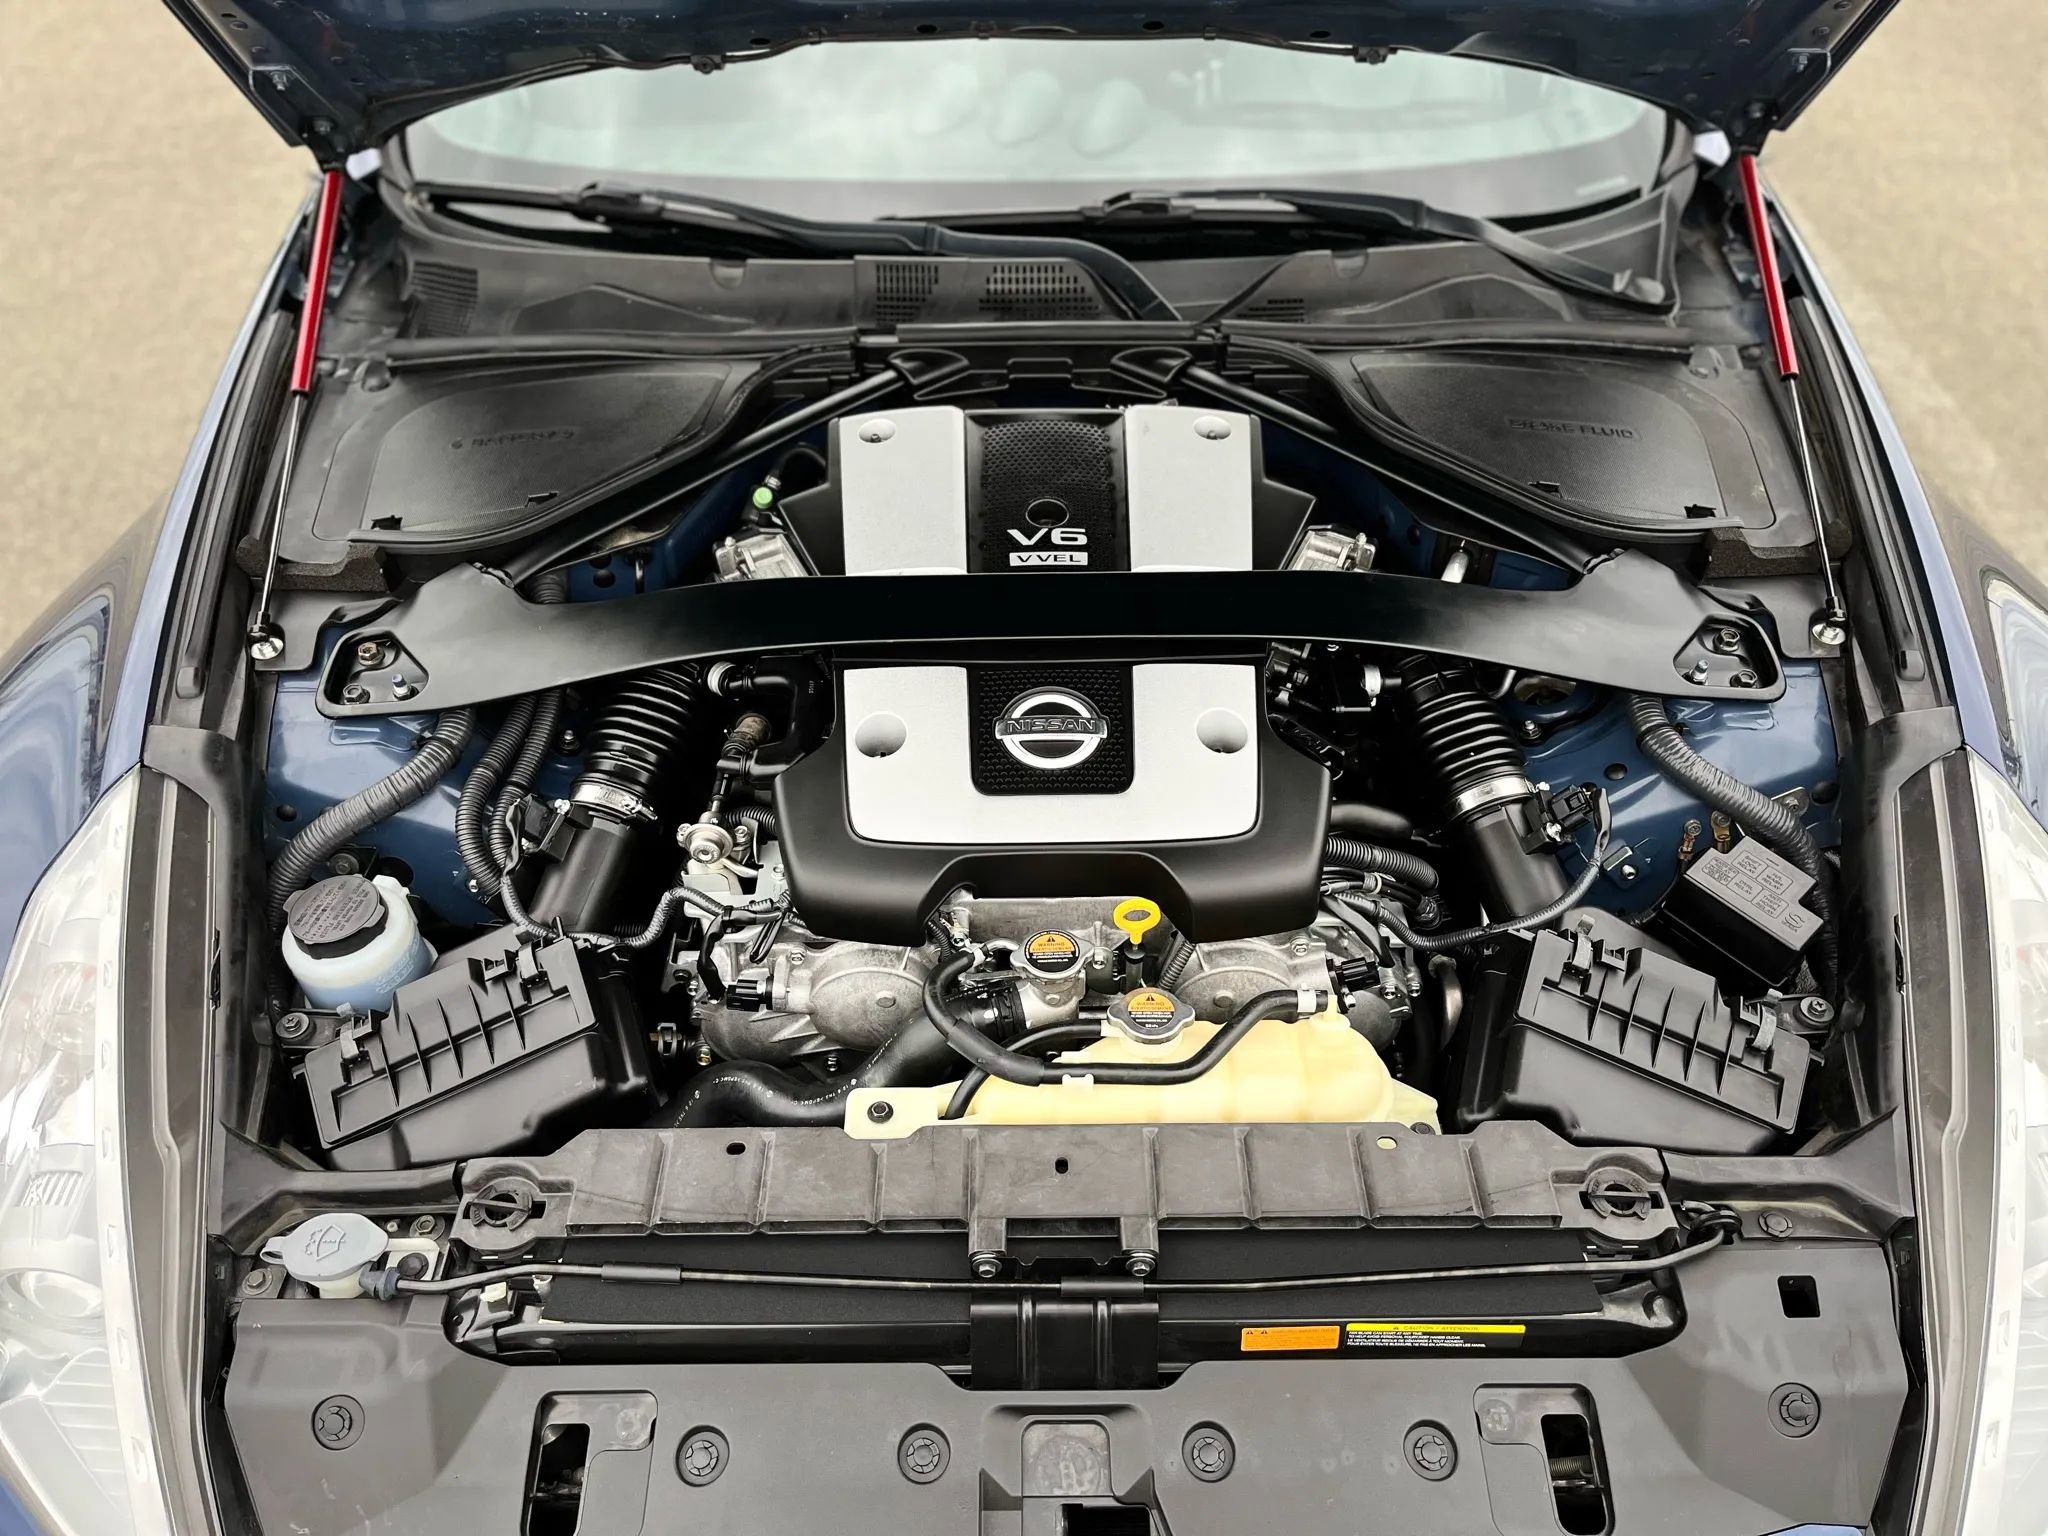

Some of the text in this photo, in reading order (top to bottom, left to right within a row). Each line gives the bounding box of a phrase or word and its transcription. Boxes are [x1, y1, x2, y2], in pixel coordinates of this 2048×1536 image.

[1580, 425, 1634, 439] FLUID
[1007, 528, 1088, 546] V6
[1016, 554, 1082, 563] VVEL
[1007, 718, 1096, 733] NISSAN
